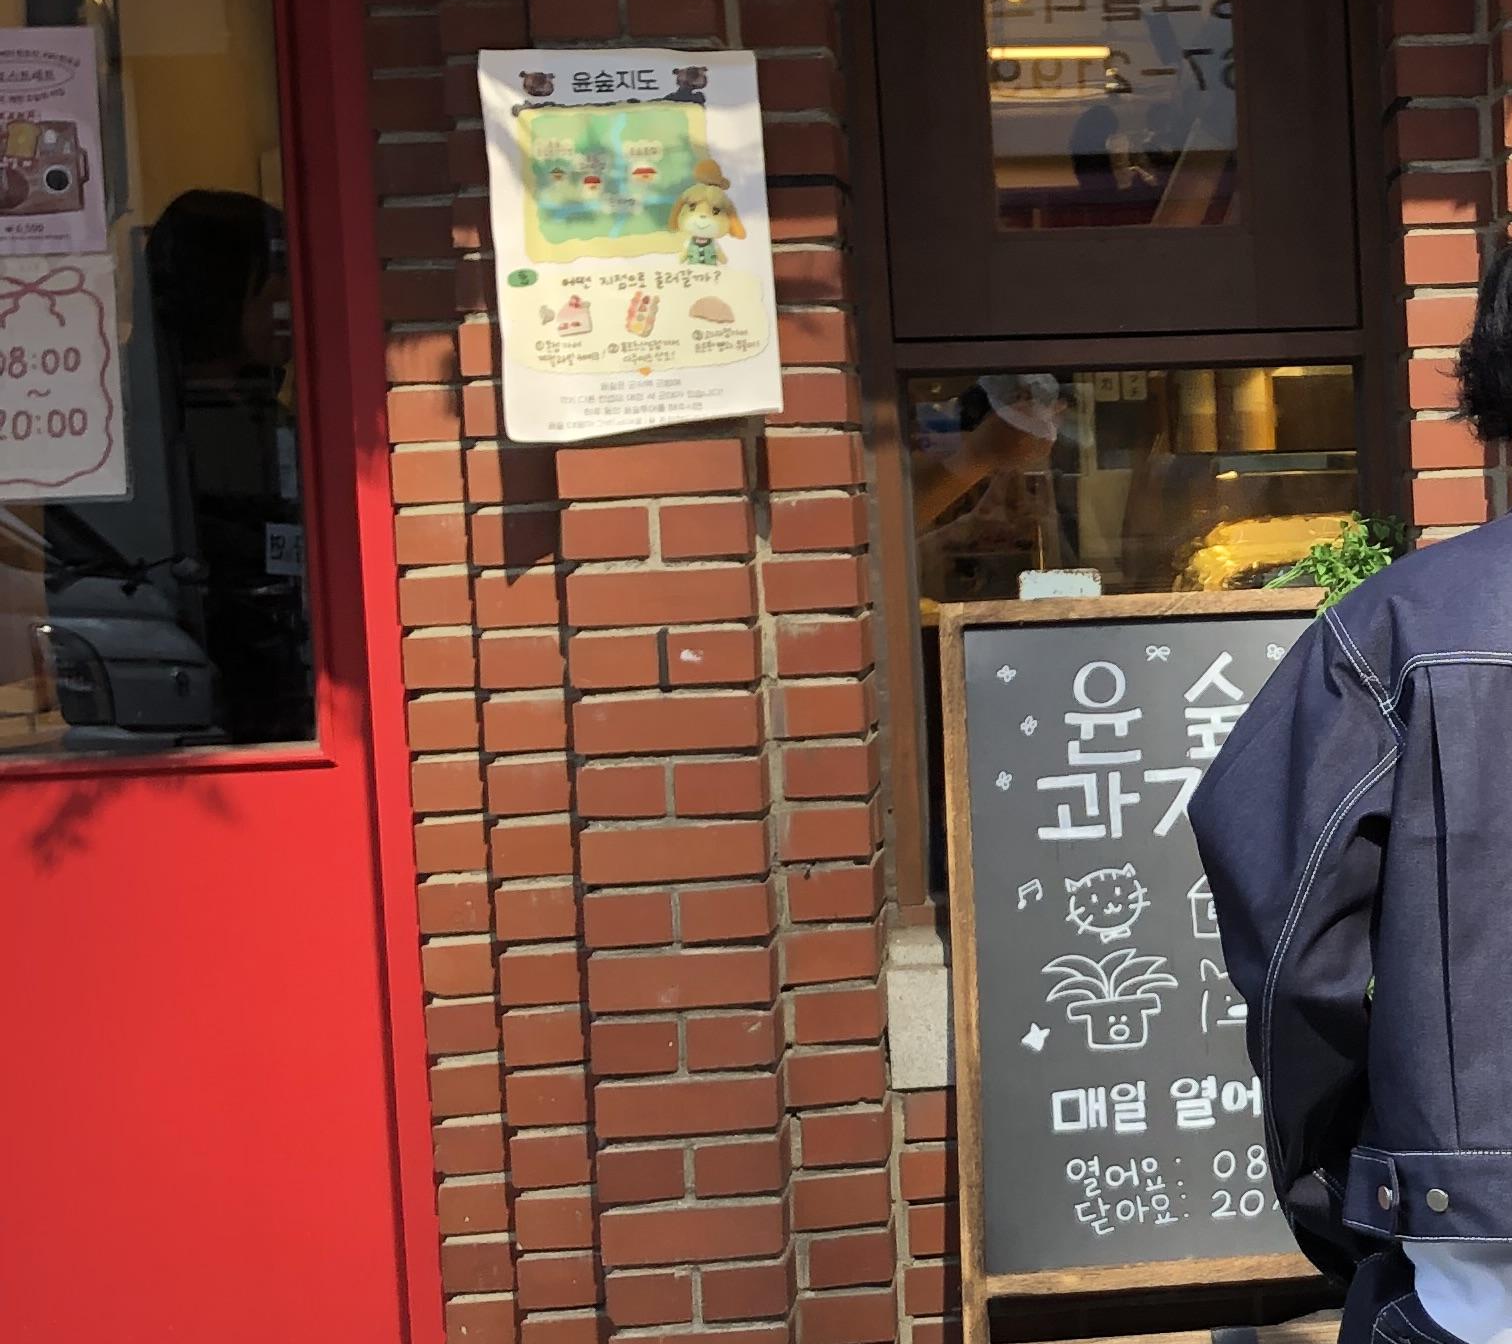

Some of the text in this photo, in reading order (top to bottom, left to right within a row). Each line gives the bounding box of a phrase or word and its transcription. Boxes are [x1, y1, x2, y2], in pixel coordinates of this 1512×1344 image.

[572, 69, 659, 93] 윤숲지도
[1051, 1080, 1148, 1133] 매일
[1211, 1189, 1281, 1218] 20
